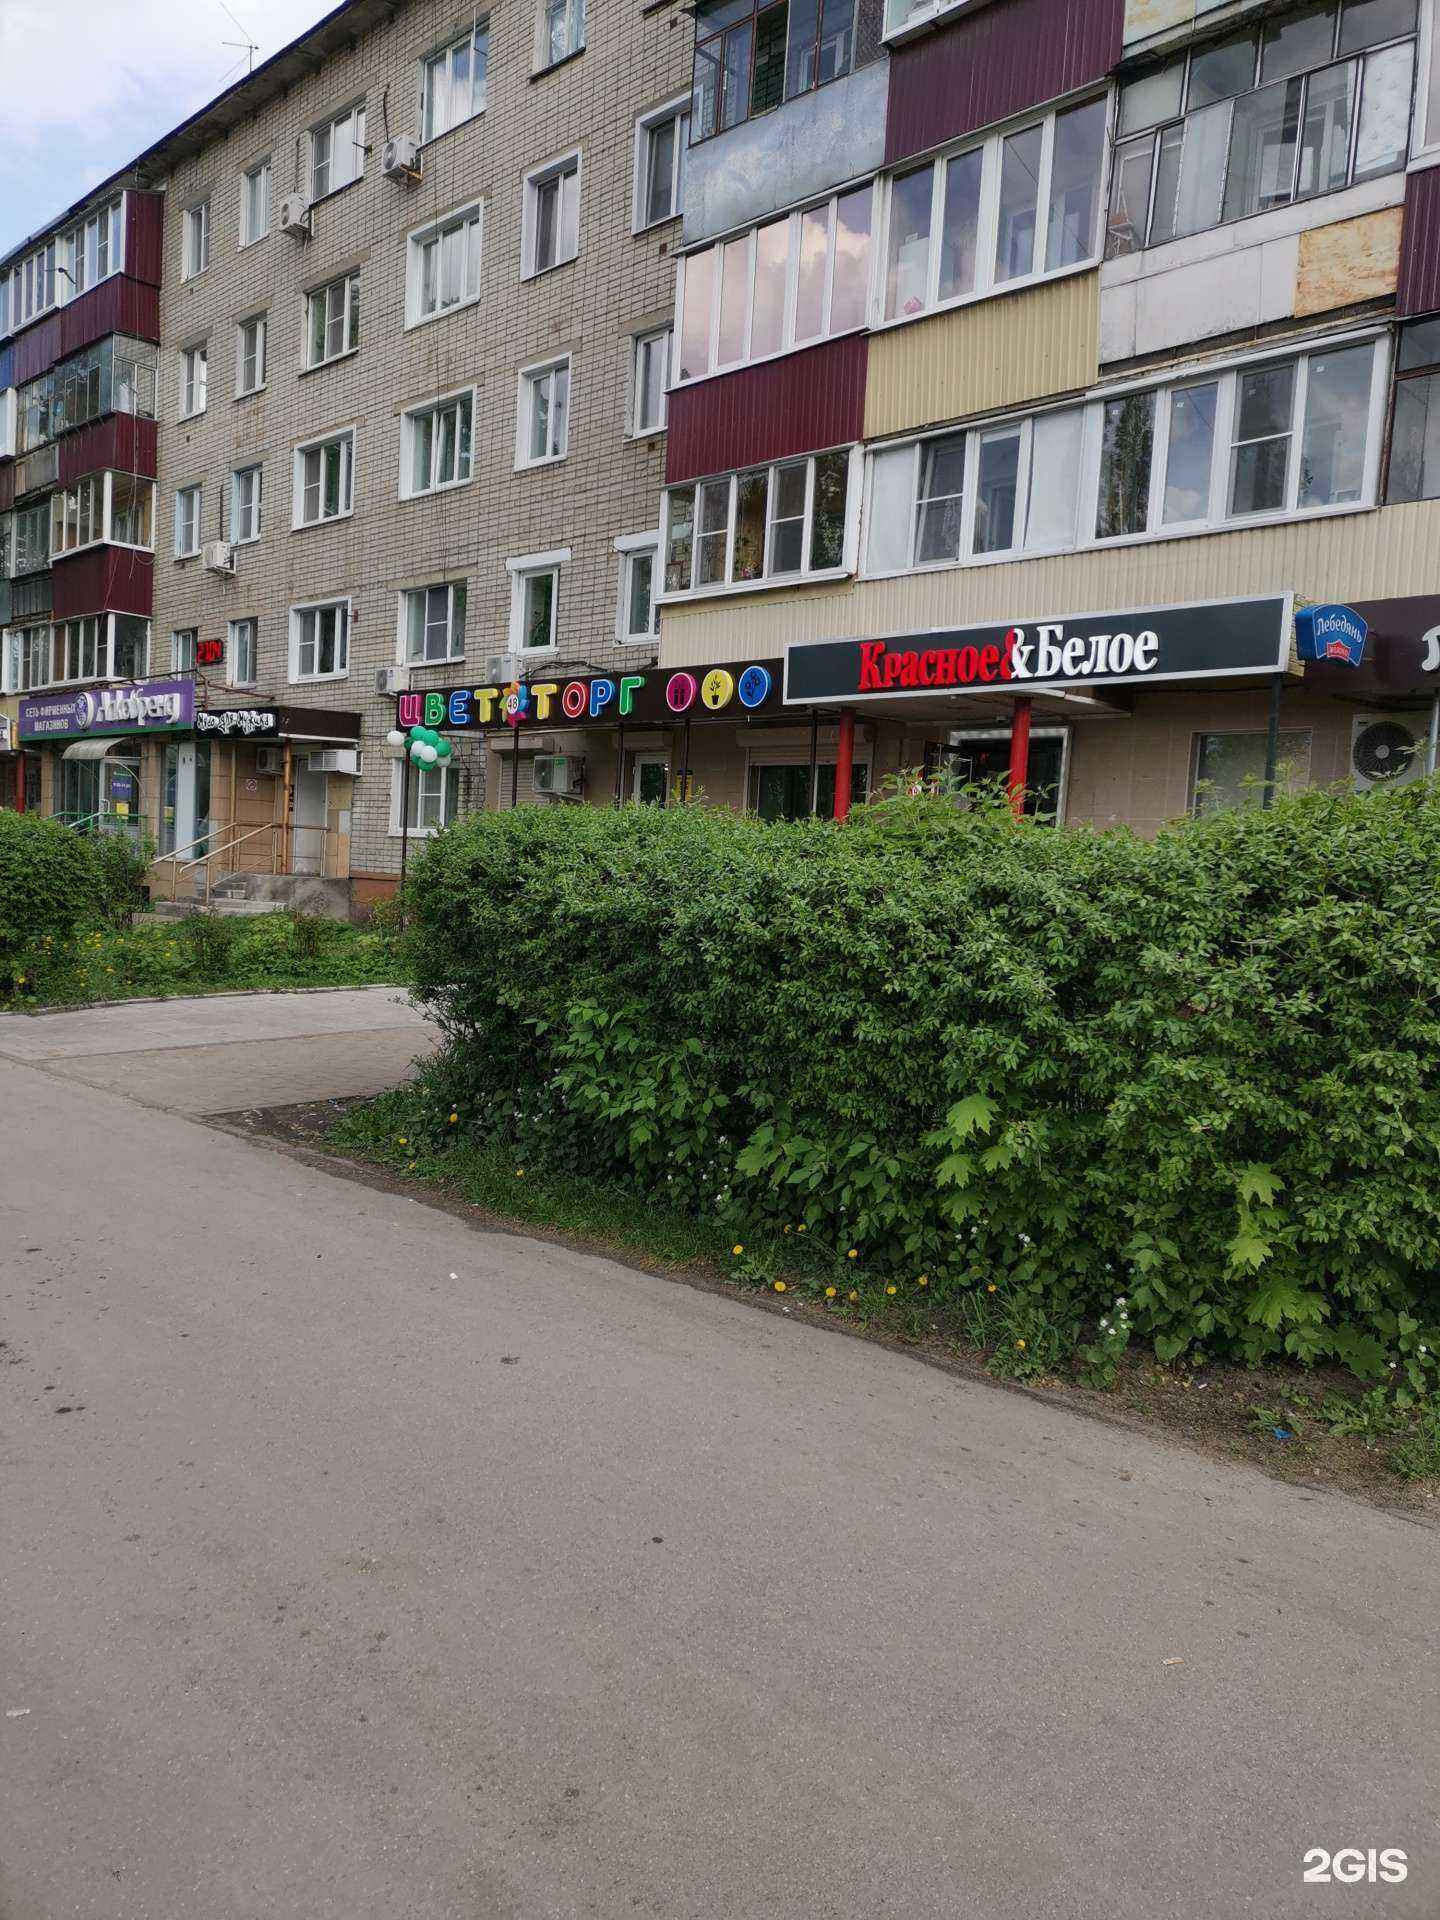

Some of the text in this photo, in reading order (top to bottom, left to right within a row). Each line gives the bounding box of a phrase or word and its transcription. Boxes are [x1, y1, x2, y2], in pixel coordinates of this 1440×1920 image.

[1317, 614, 1362, 643] Лебедянь
[399, 688, 498, 727] ЦВЕТ
[530, 676, 645, 721] ТОРГ
[34, 719, 69, 732] МАГАЗИНОВ
